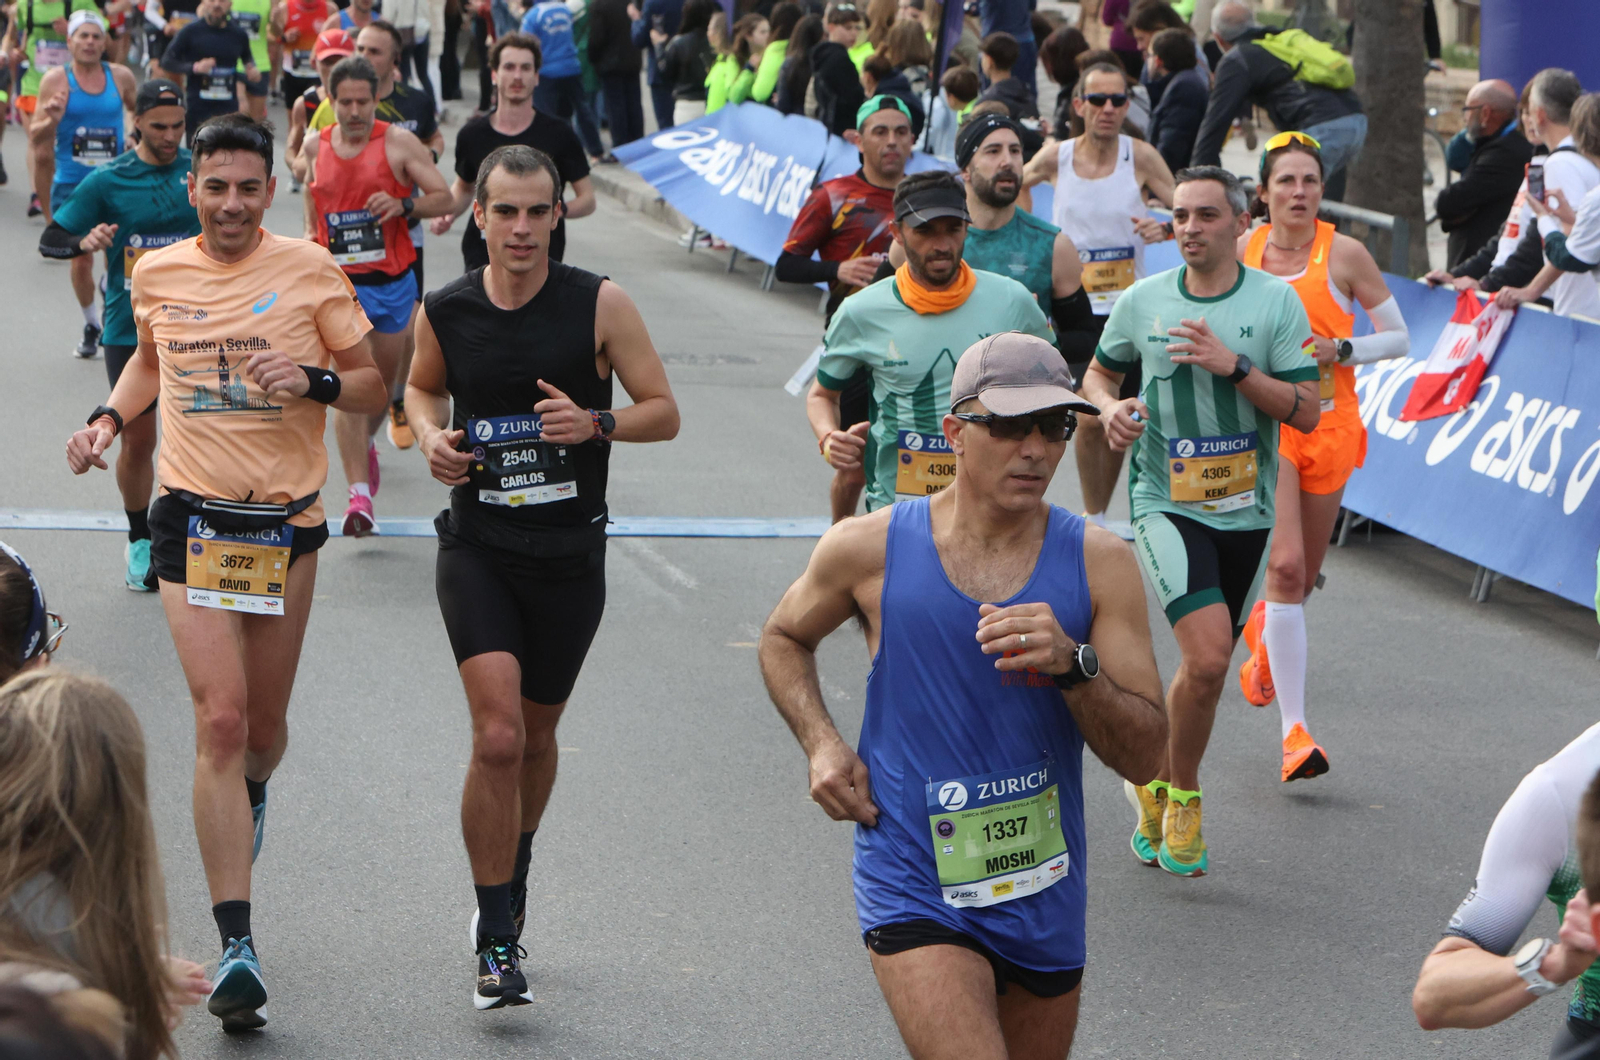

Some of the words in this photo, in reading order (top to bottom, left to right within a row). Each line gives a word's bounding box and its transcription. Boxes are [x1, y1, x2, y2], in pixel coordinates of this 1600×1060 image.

[168, 340, 216, 352] Maratón
[1200, 438, 1249, 453] ZURICH
[1470, 392, 1581, 493] asics
[502, 448, 537, 466] 2540
[500, 472, 546, 488] CARLOS
[1202, 466, 1231, 480] 4305
[1205, 486, 1229, 498] KEKE
[220, 554, 254, 569] 3672
[219, 578, 250, 591] DAVID
[977, 768, 1048, 800] ZURICH
[982, 816, 1028, 843] 1337
[986, 849, 1035, 874] MOSHI
